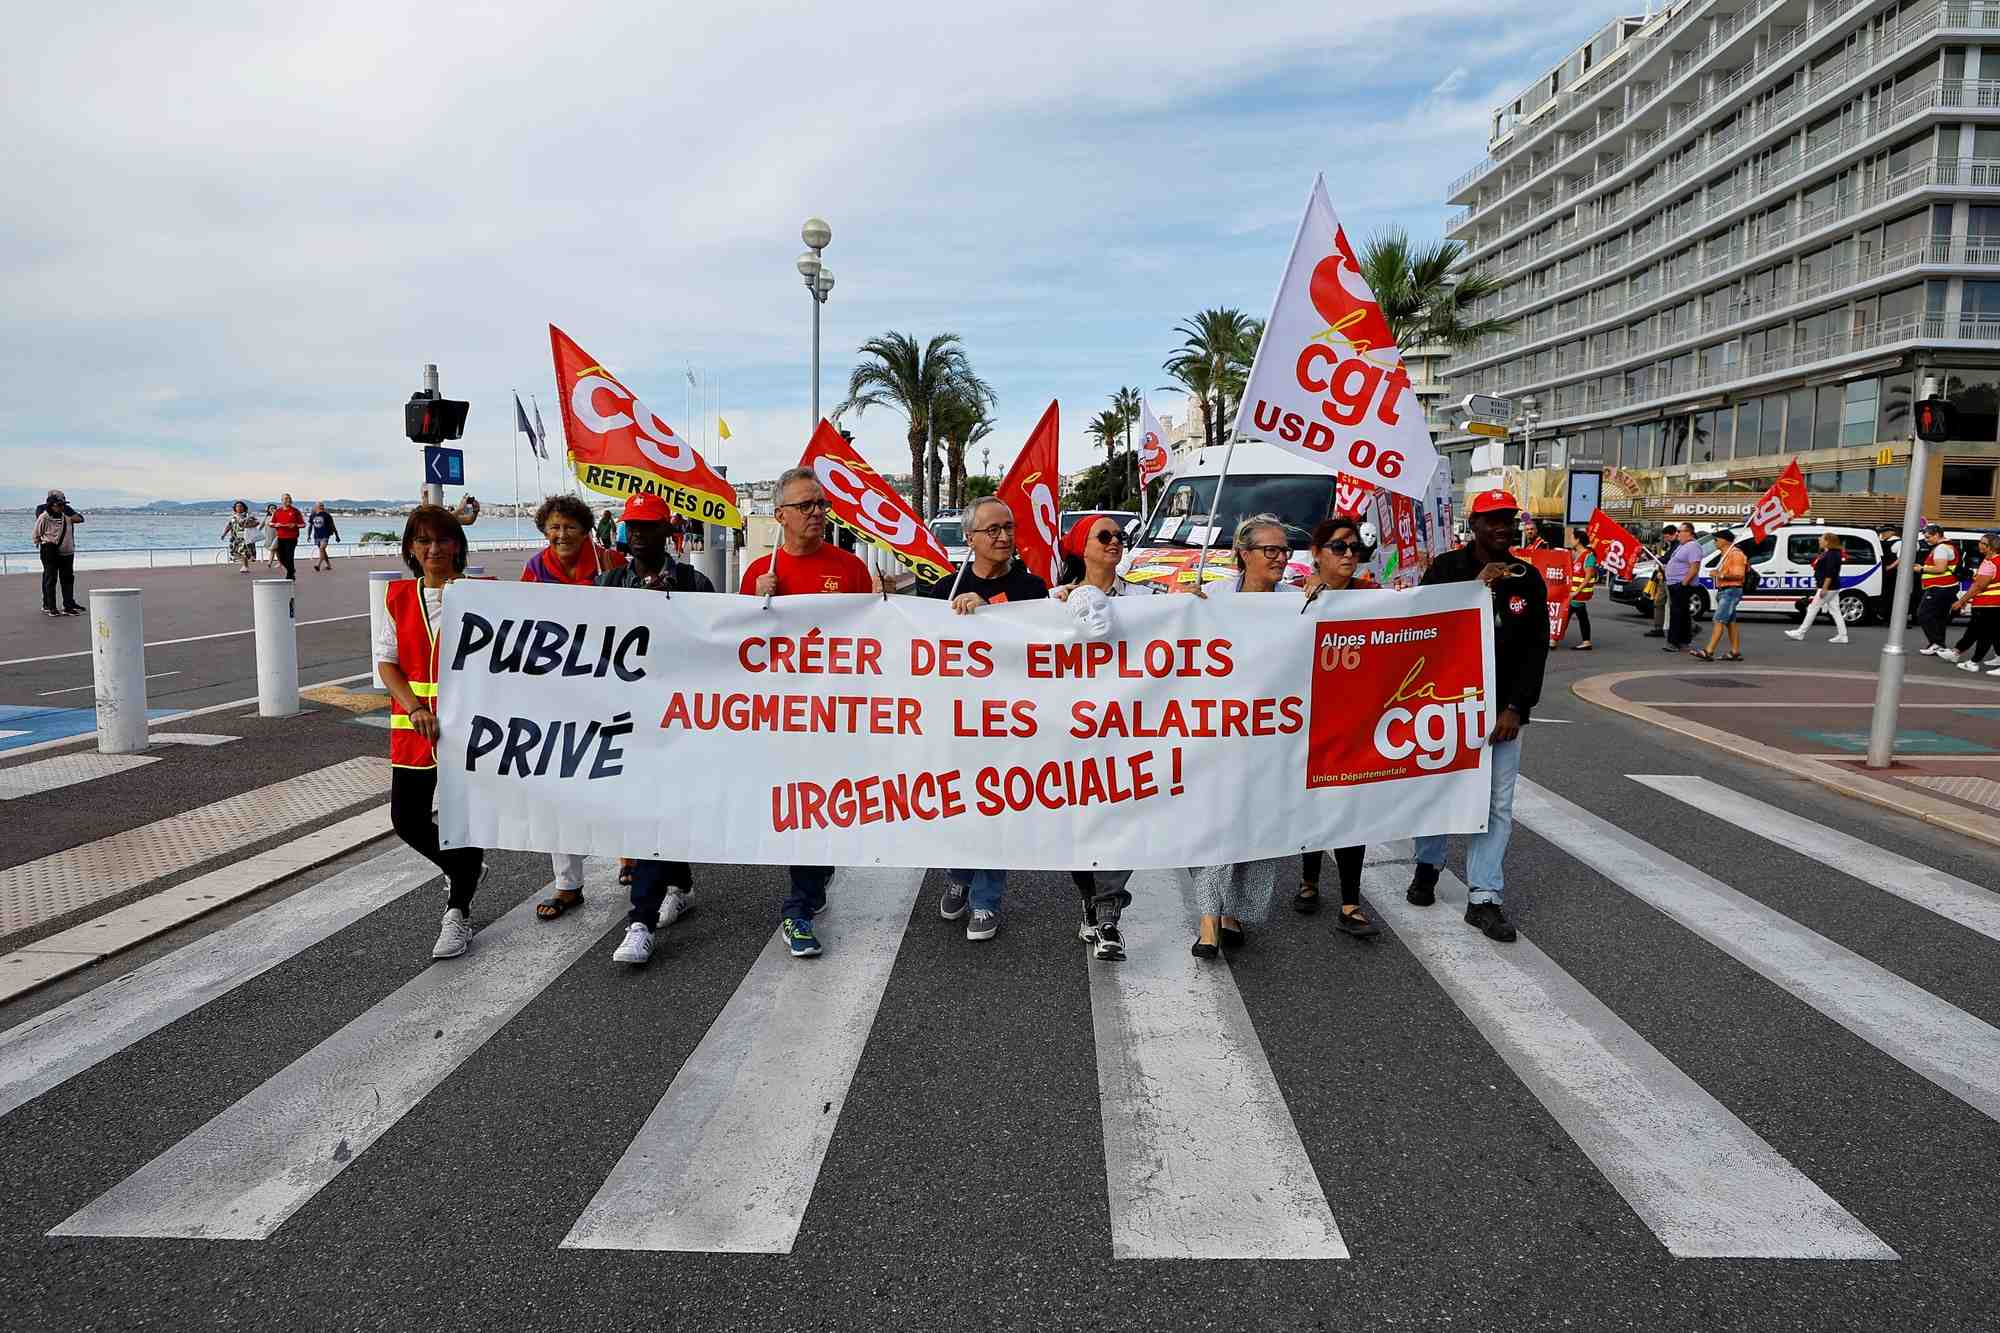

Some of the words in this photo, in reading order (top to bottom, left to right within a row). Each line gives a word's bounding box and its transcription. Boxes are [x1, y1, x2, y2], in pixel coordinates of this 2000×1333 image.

[1295, 343, 1411, 426] cgt
[572, 375, 725, 481] cg
[1254, 399, 1336, 453] USD
[1347, 439, 1405, 479] 06
[586, 465, 698, 512] RETRAITÉS
[703, 500, 726, 521] 06
[814, 456, 948, 558] cg
[1672, 503, 1755, 514] McDonald
[452, 612, 650, 682] PUBLIC
[738, 627, 882, 674] CRÉER
[911, 639, 994, 678] DES
[1027, 638, 1233, 679] EMPLOIS
[1320, 646, 1361, 671] 06
[1321, 633, 1366, 649] Alpes
[1370, 626, 1438, 645] Maritimes
[465, 711, 634, 780] PRIVÉ
[660, 692, 922, 736] AUGMENTER
[954, 699, 1038, 738] LES
[1070, 696, 1304, 739] SALAIRES
[1373, 687, 1486, 770] cgt
[772, 767, 965, 833] URGENCE
[975, 750, 1159, 817] SOCIALE
[1312, 774, 1338, 783] Union
[1340, 767, 1407, 782] Départementale
